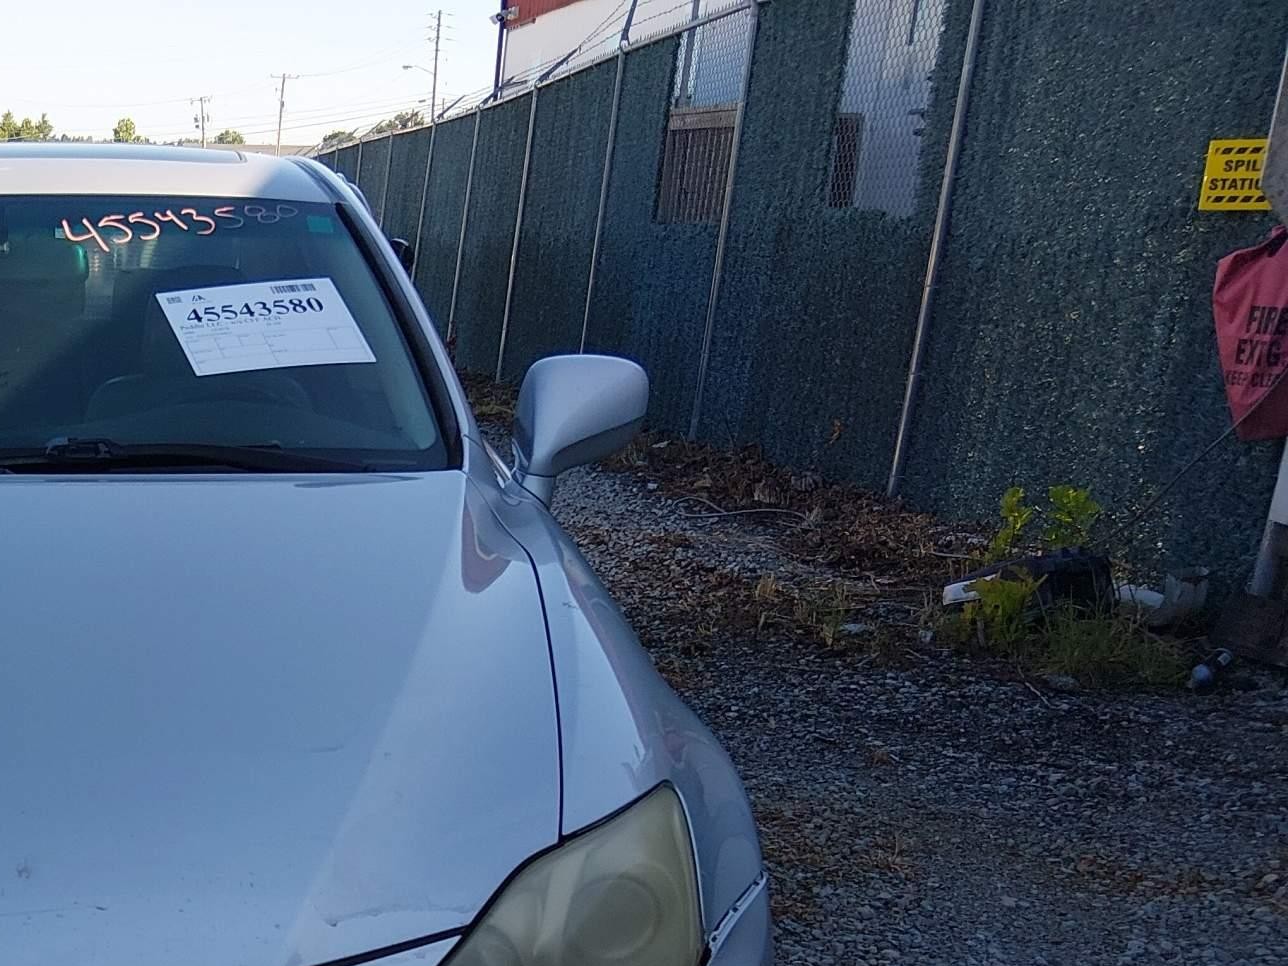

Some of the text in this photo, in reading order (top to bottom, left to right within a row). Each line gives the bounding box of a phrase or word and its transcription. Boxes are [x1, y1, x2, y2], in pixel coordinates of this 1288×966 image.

[1223, 159, 1261, 172] SPIL
[1209, 178, 1261, 191] STATI
[62, 205, 298, 252] 45543580
[187, 297, 323, 323] 45543580
